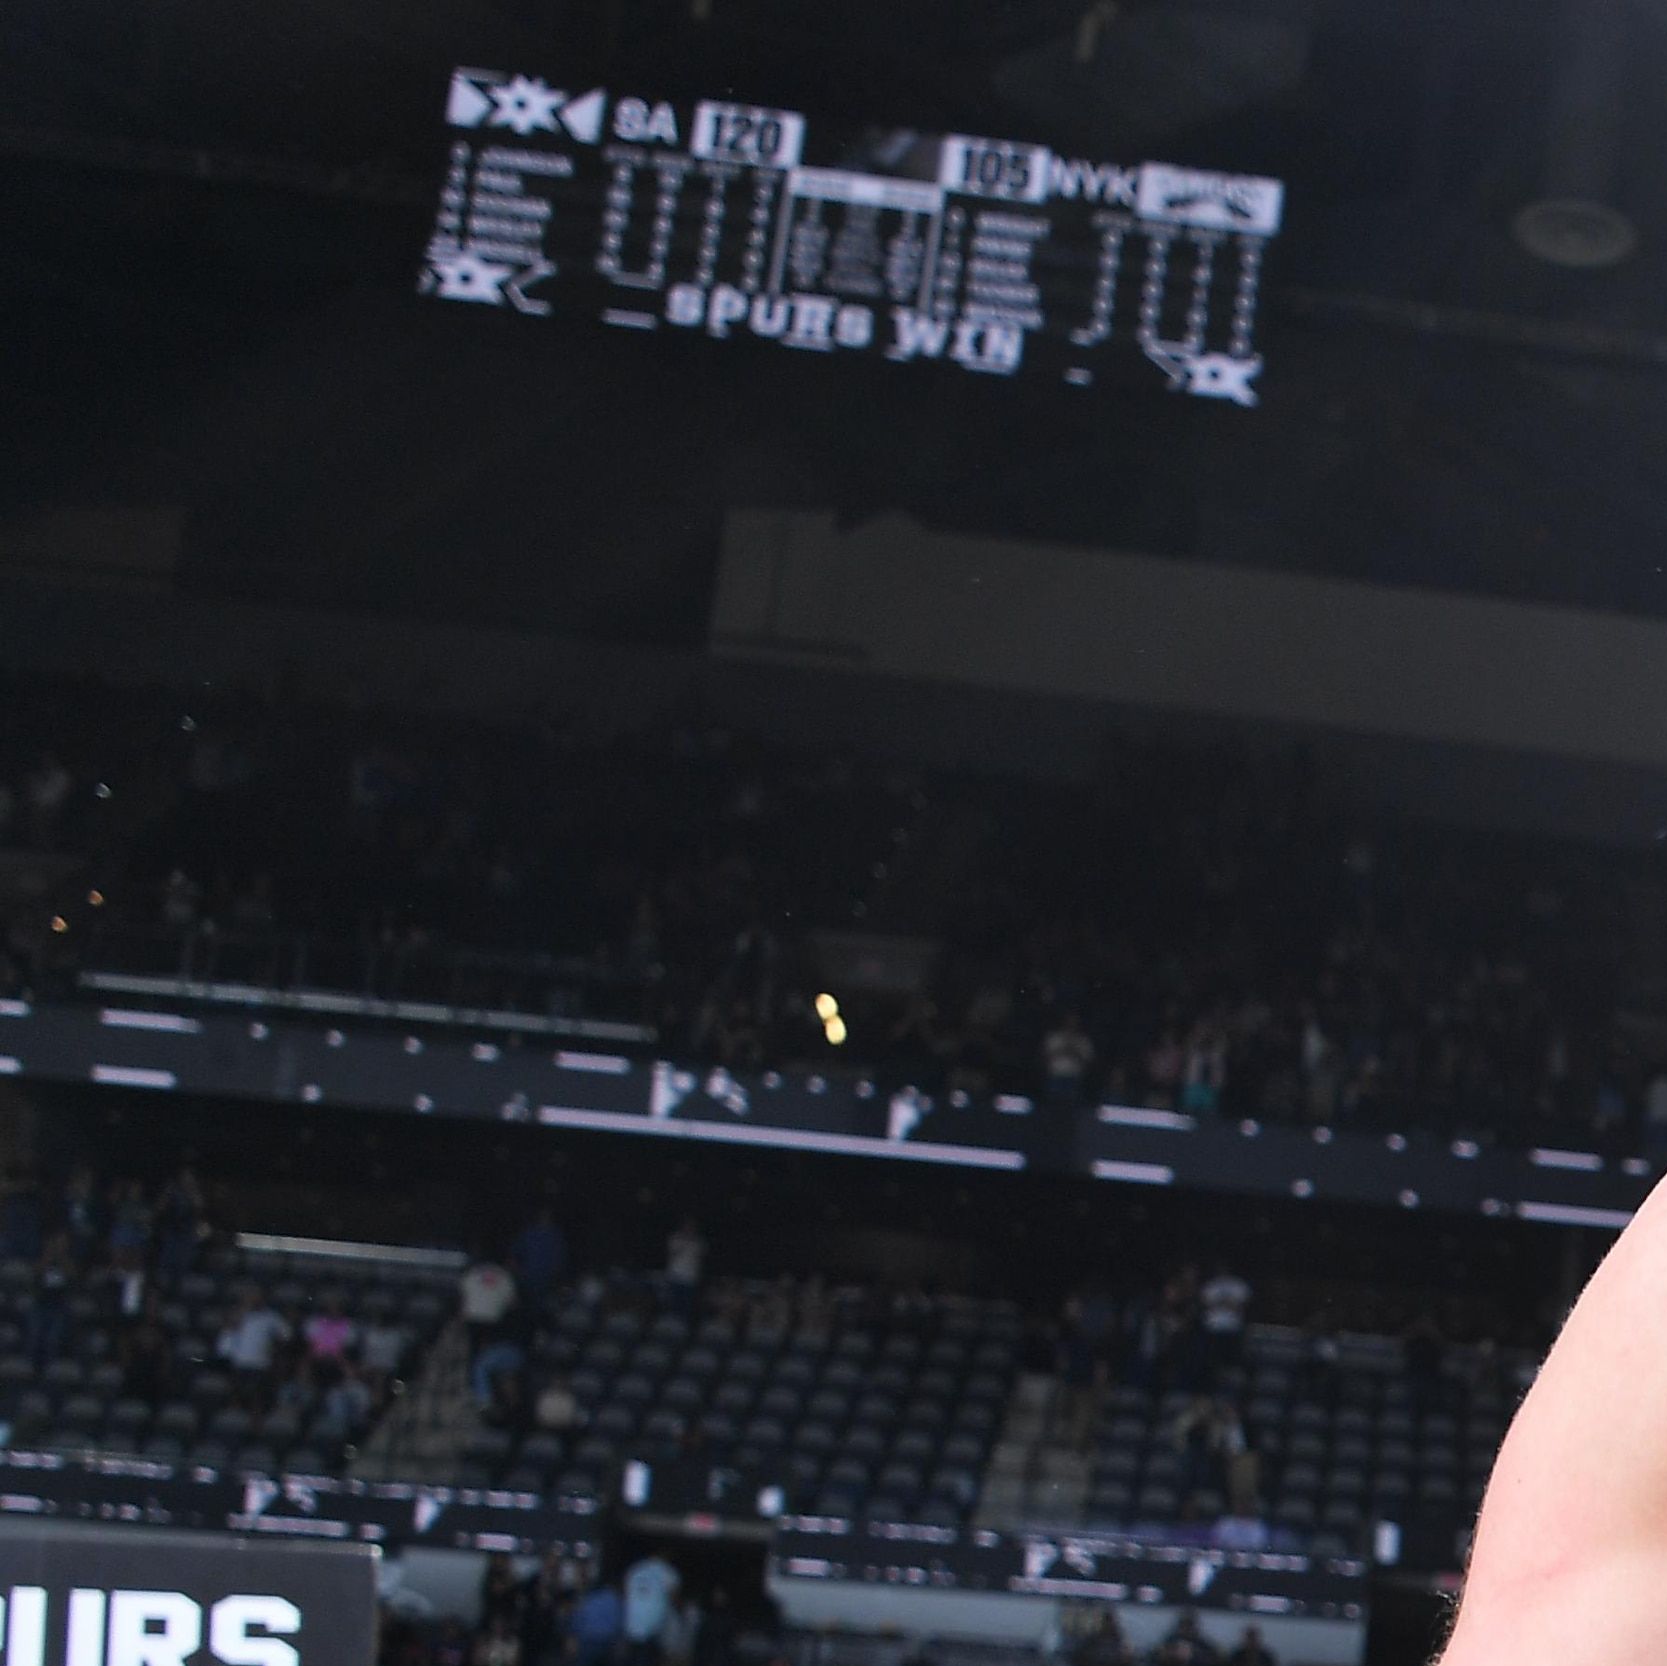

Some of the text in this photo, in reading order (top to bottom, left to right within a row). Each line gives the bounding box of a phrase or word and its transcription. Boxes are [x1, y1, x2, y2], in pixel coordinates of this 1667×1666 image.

[614, 97, 782, 153] SA 120
[963, 145, 1030, 189] 105
[666, 283, 1023, 376] SPURS WIN
